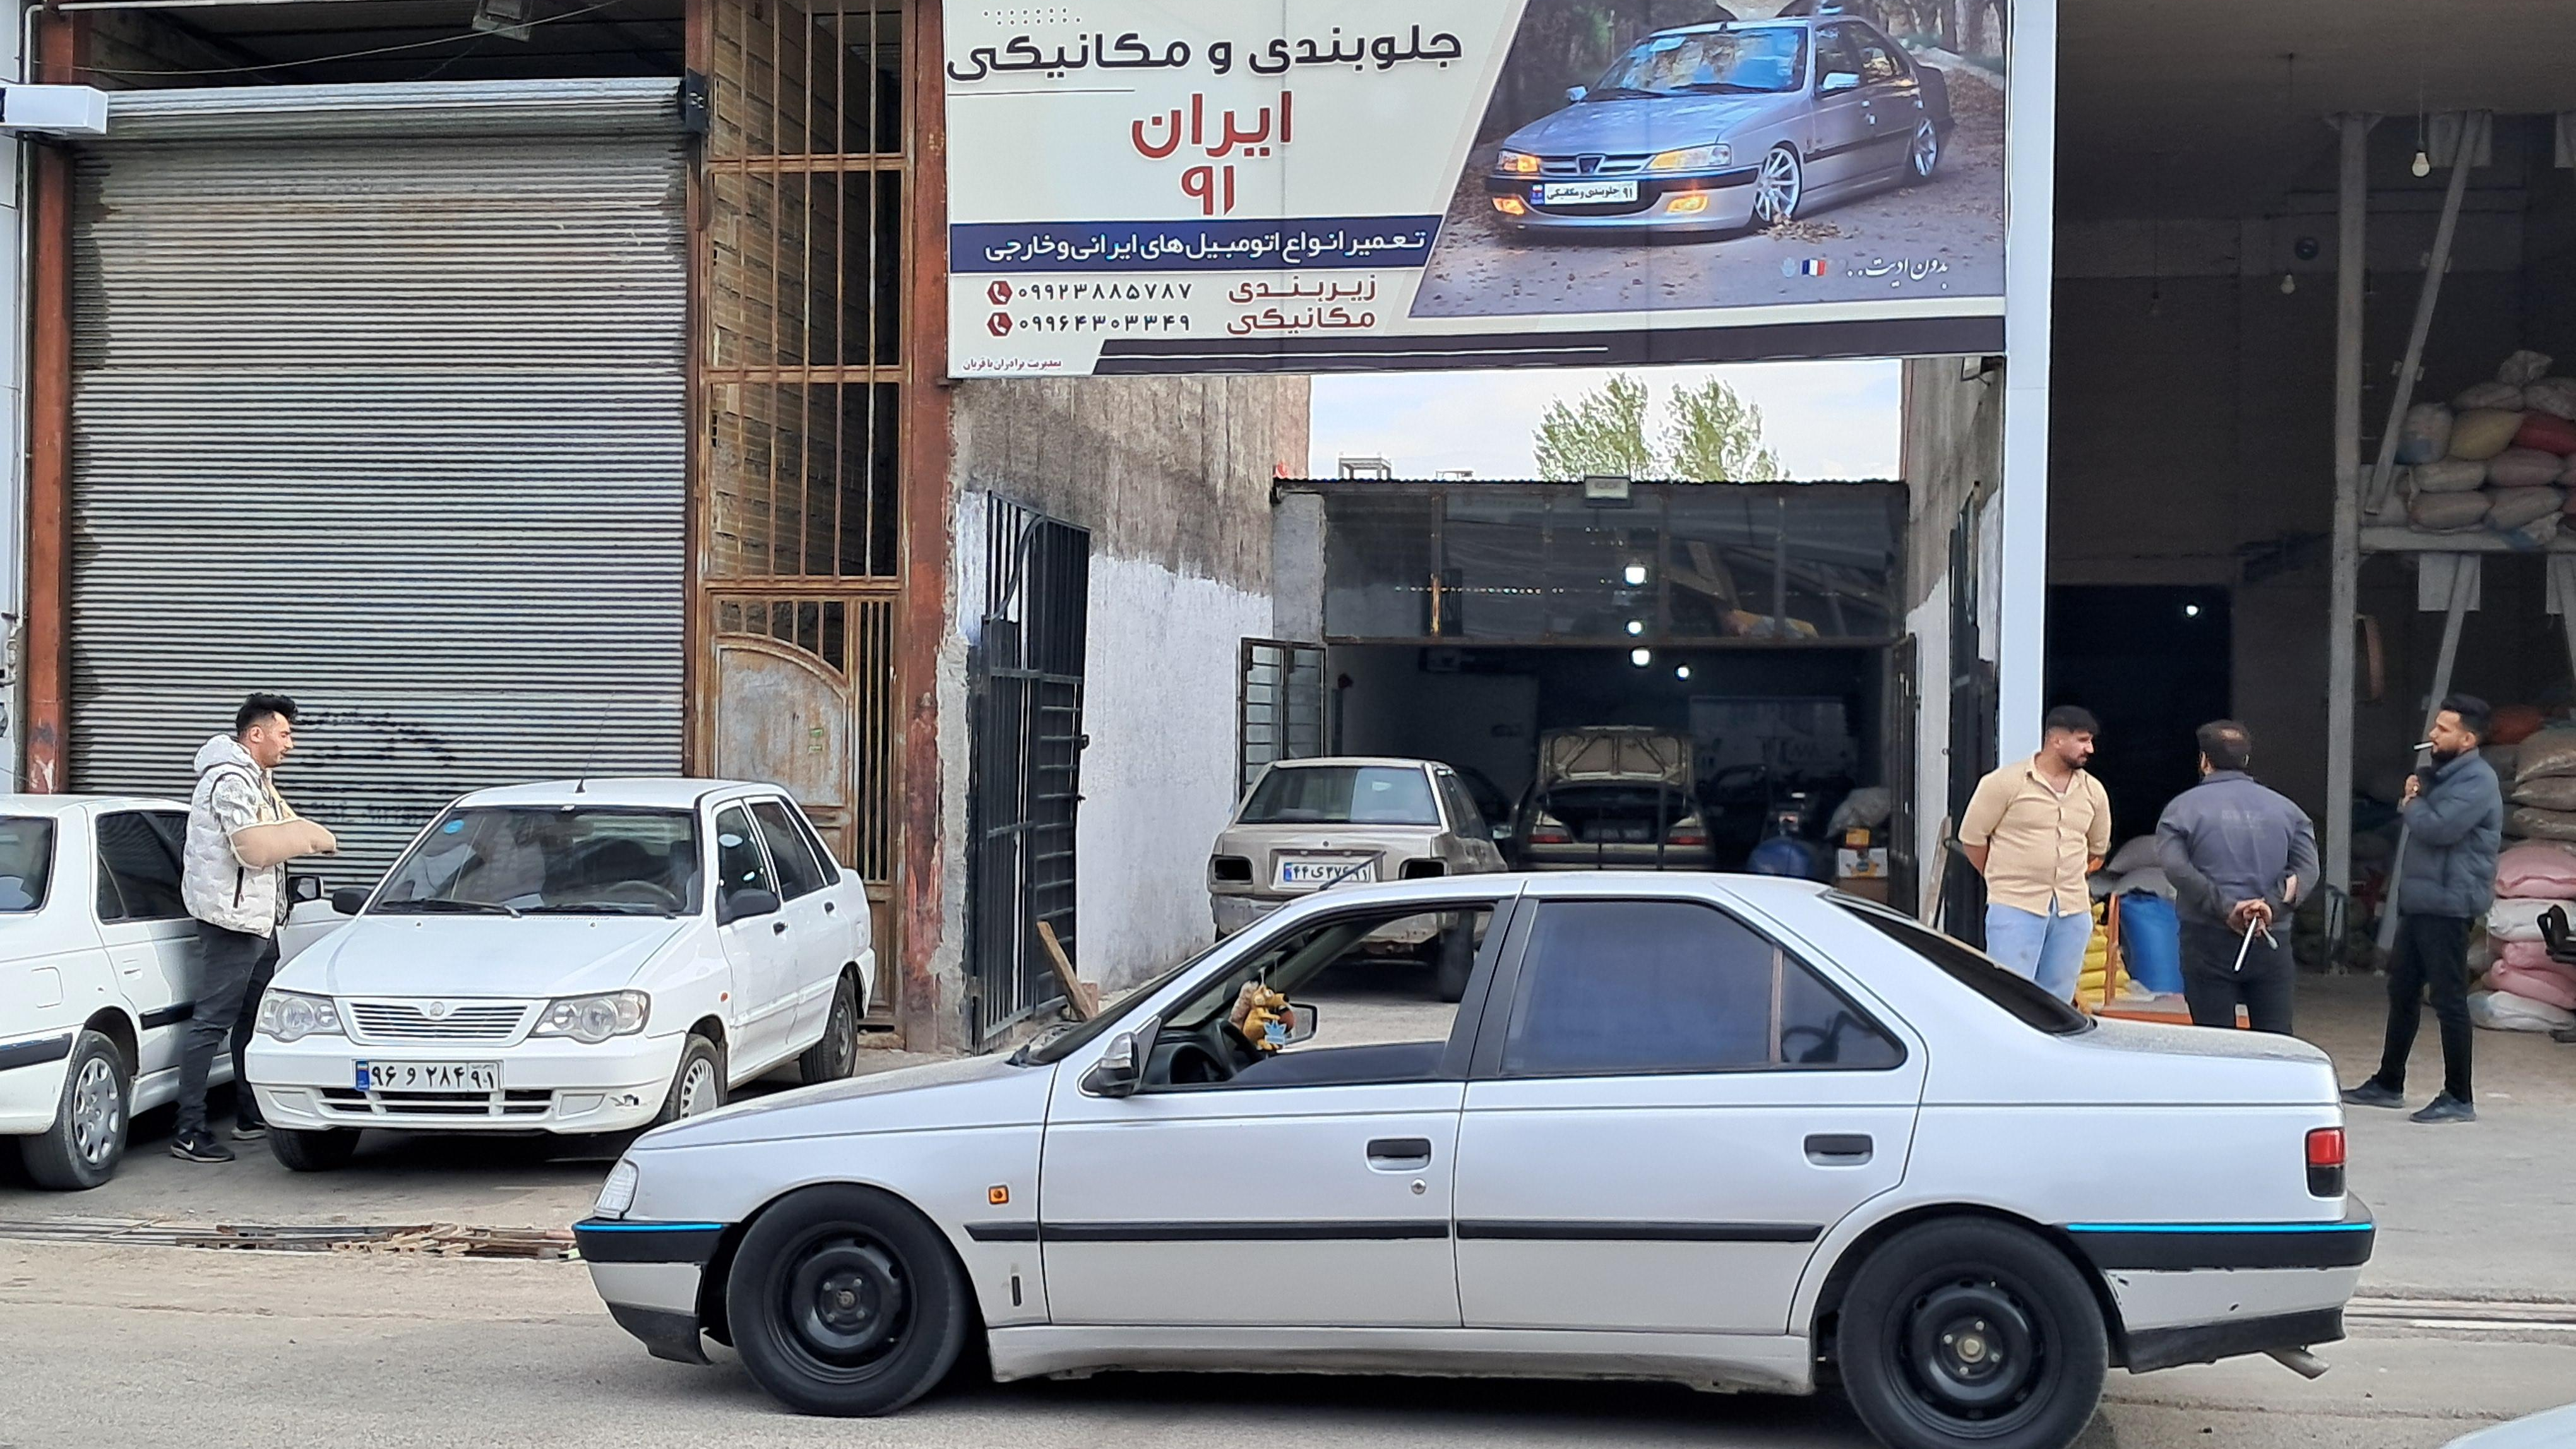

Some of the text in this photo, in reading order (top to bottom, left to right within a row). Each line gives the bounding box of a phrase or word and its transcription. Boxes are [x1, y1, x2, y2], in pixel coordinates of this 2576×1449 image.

[948, 25, 1462, 80] جلوبندی و مکانیکی
[1133, 91, 1292, 158] ایران
[1183, 166, 1235, 215] ۹۱
[1071, 234, 1136, 261] ایرانی
[1141, 234, 1183, 259] های
[1186, 232, 1280, 259] اتومبیل
[1282, 230, 1344, 263] انواع
[1344, 232, 1426, 258] تعمیر
[1909, 258, 1949, 290] بدون
[1229, 275, 1375, 302] زیربندی
[1227, 307, 1375, 335] مکانیکی
